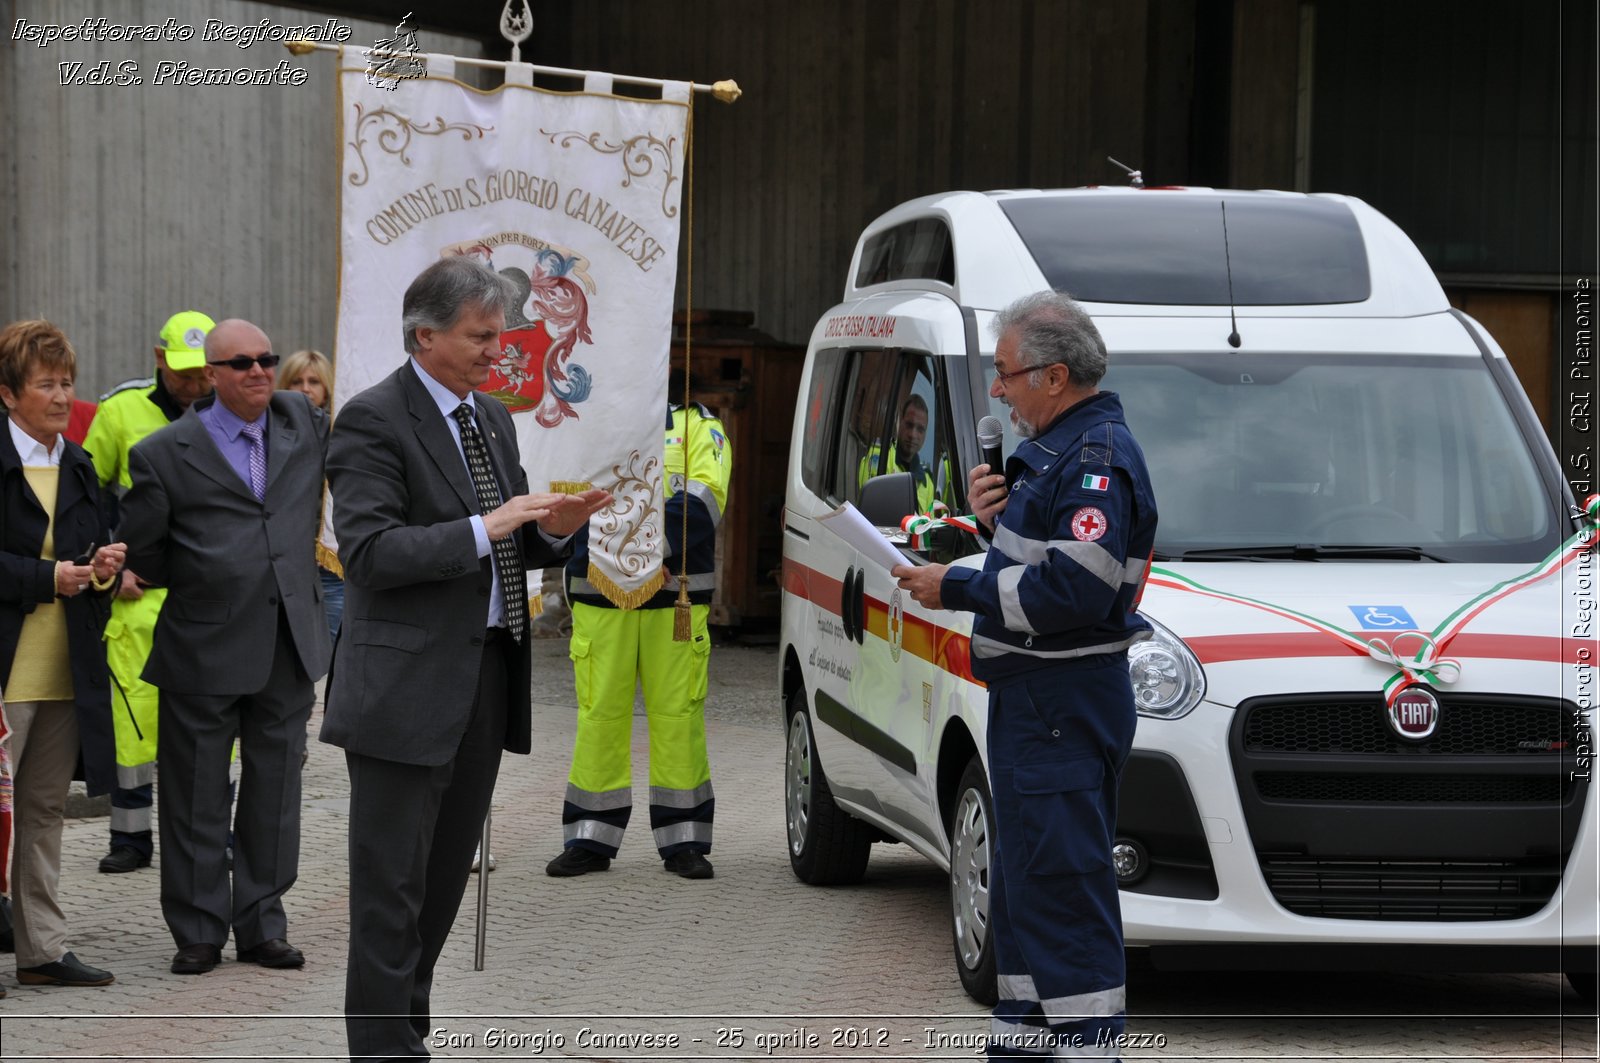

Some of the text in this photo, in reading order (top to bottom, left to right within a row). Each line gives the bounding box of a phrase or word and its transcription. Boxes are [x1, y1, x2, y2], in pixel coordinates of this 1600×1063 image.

[366, 182, 444, 246] COMUNE
[443, 187, 465, 212] DI
[564, 187, 666, 273] CANAVESE
[500, 233, 520, 243] PER
[825, 315, 897, 339] CROCE ROSSA ITALIANA
[1401, 703, 1430, 725] FIAT
